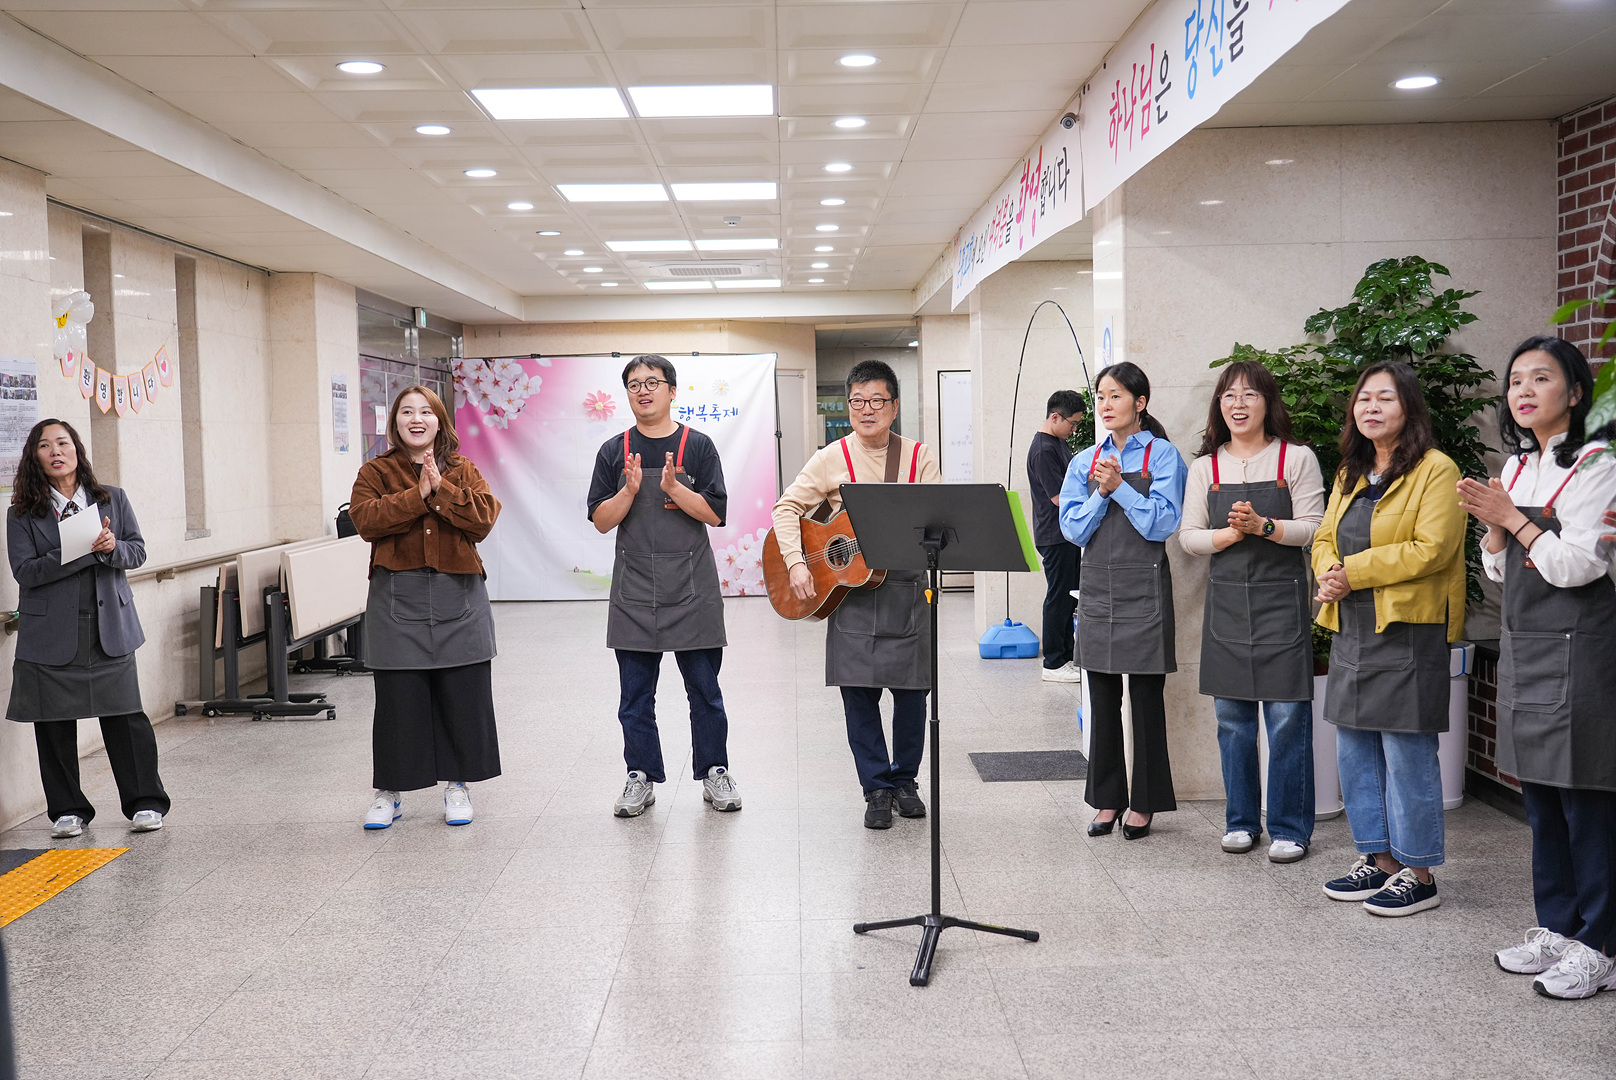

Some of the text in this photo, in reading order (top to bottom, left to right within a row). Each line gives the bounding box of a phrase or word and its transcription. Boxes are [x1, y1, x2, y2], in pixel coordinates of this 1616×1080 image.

[1109, 0, 1249, 165] 하나님은 당신을
[988, 194, 1014, 258] 여러분을
[1015, 145, 1070, 251] 환영합니다
[83, 368, 154, 404] 환영합니다
[678, 404, 739, 422] 행복축제
